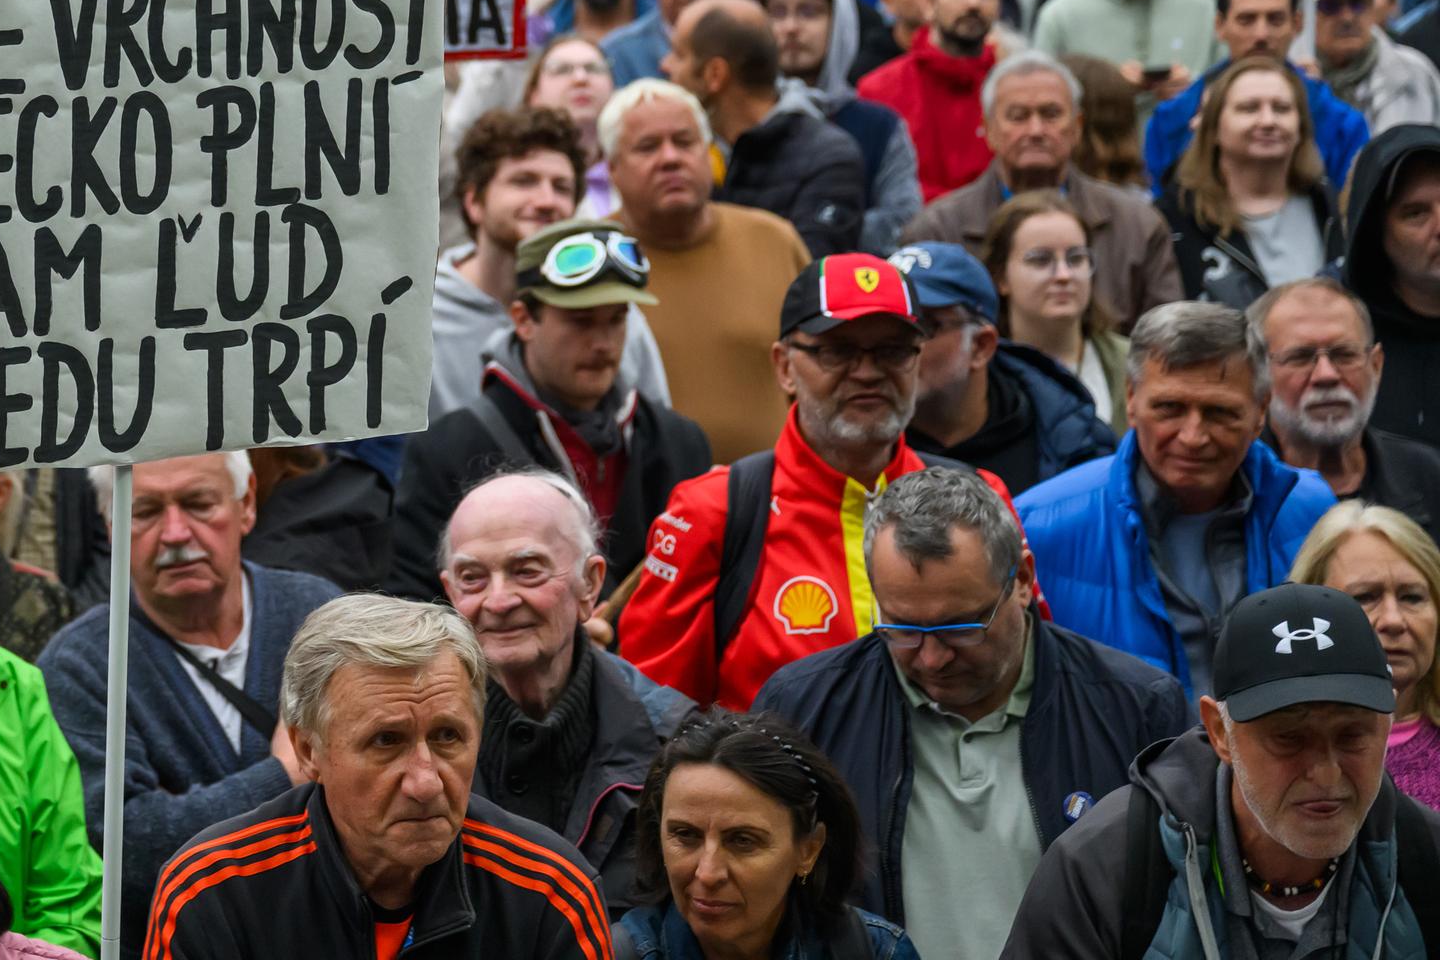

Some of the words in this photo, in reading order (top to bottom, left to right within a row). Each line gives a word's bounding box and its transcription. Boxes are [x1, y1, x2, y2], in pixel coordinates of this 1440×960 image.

[196, 71, 424, 207] PLNÍ
[155, 203, 344, 329] ĽUD
[183, 276, 414, 451] TRPÍ
